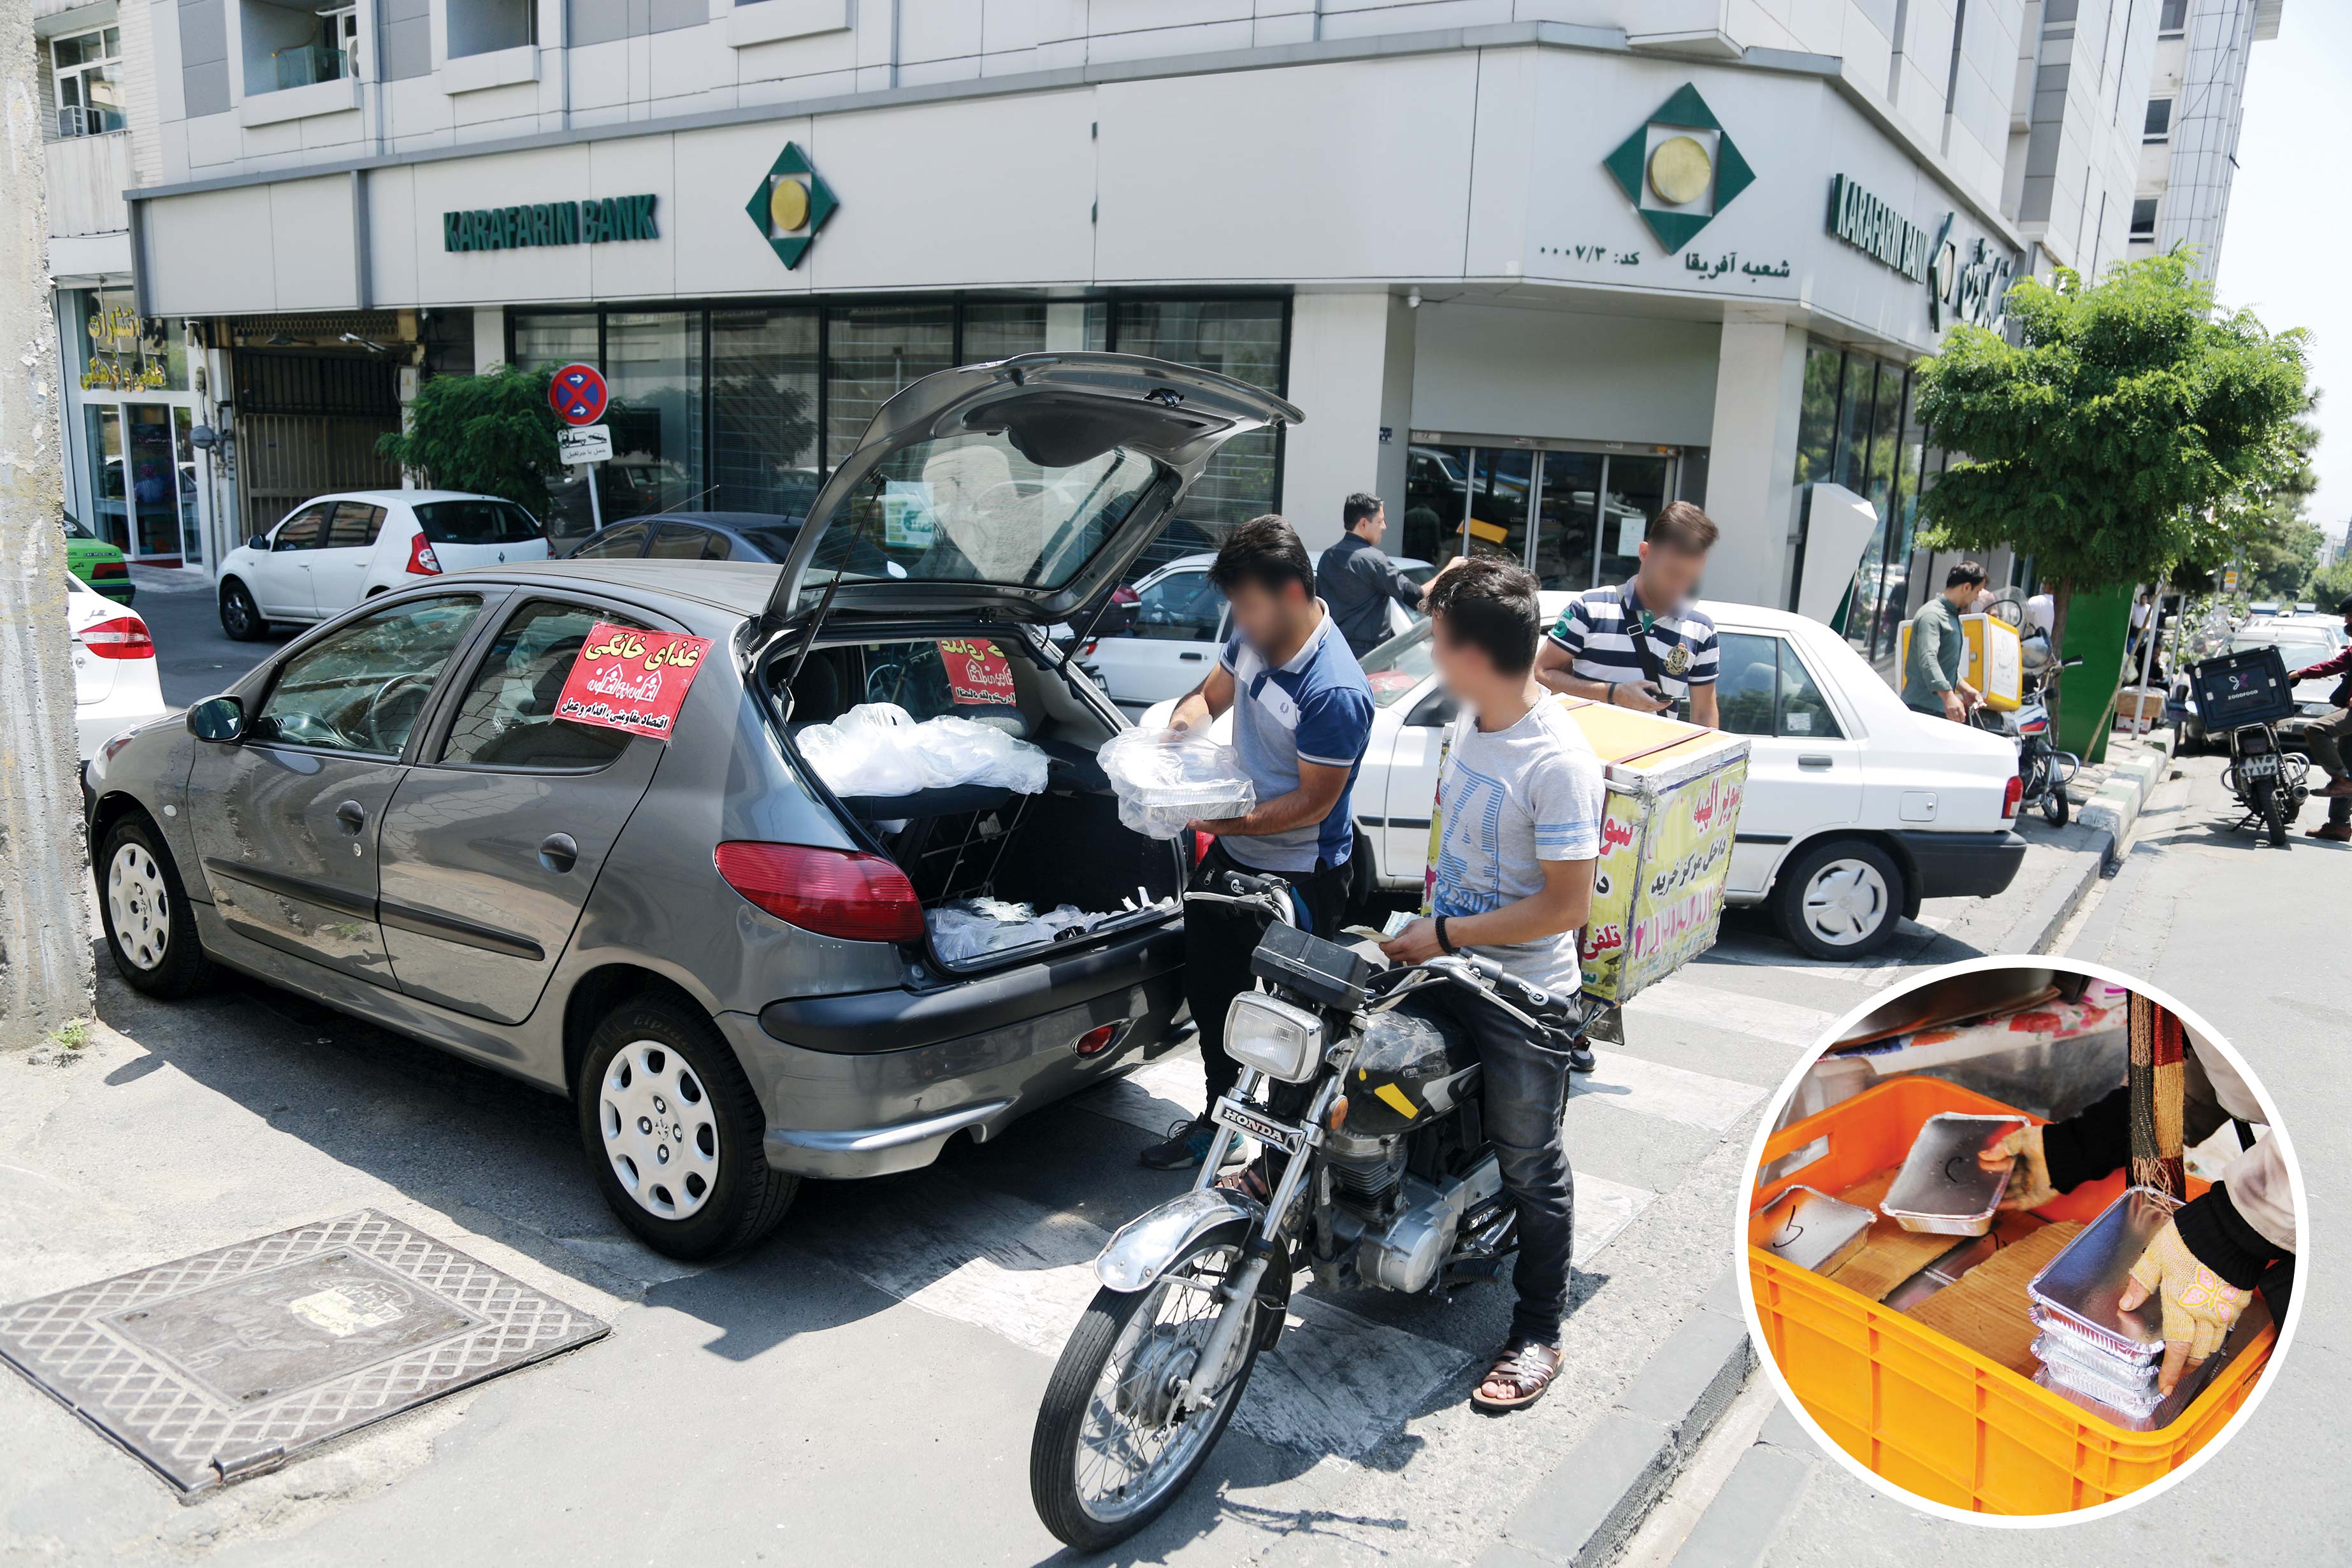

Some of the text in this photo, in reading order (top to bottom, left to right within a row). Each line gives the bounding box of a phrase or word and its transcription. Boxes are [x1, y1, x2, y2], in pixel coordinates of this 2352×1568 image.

[444, 194, 659, 252] KARAFARIN BANK
[1833, 173, 1902, 270] KARAFARIN
[1685, 252, 1737, 279] آفریقا
[1742, 260, 1790, 282] شعبه
[89, 306, 141, 344] انتشارات
[584, 633, 700, 671] غذای خانگی
[561, 698, 579, 714] عمل
[579, 706, 584, 716] و
[584, 703, 606, 719] اقدام
[640, 711, 668, 730] اقتصاد
[1651, 837, 1726, 896] داخل مرکز خرید
[1518, 983, 1543, 1000] KENDA
[1223, 1108, 1283, 1143] HONDA
